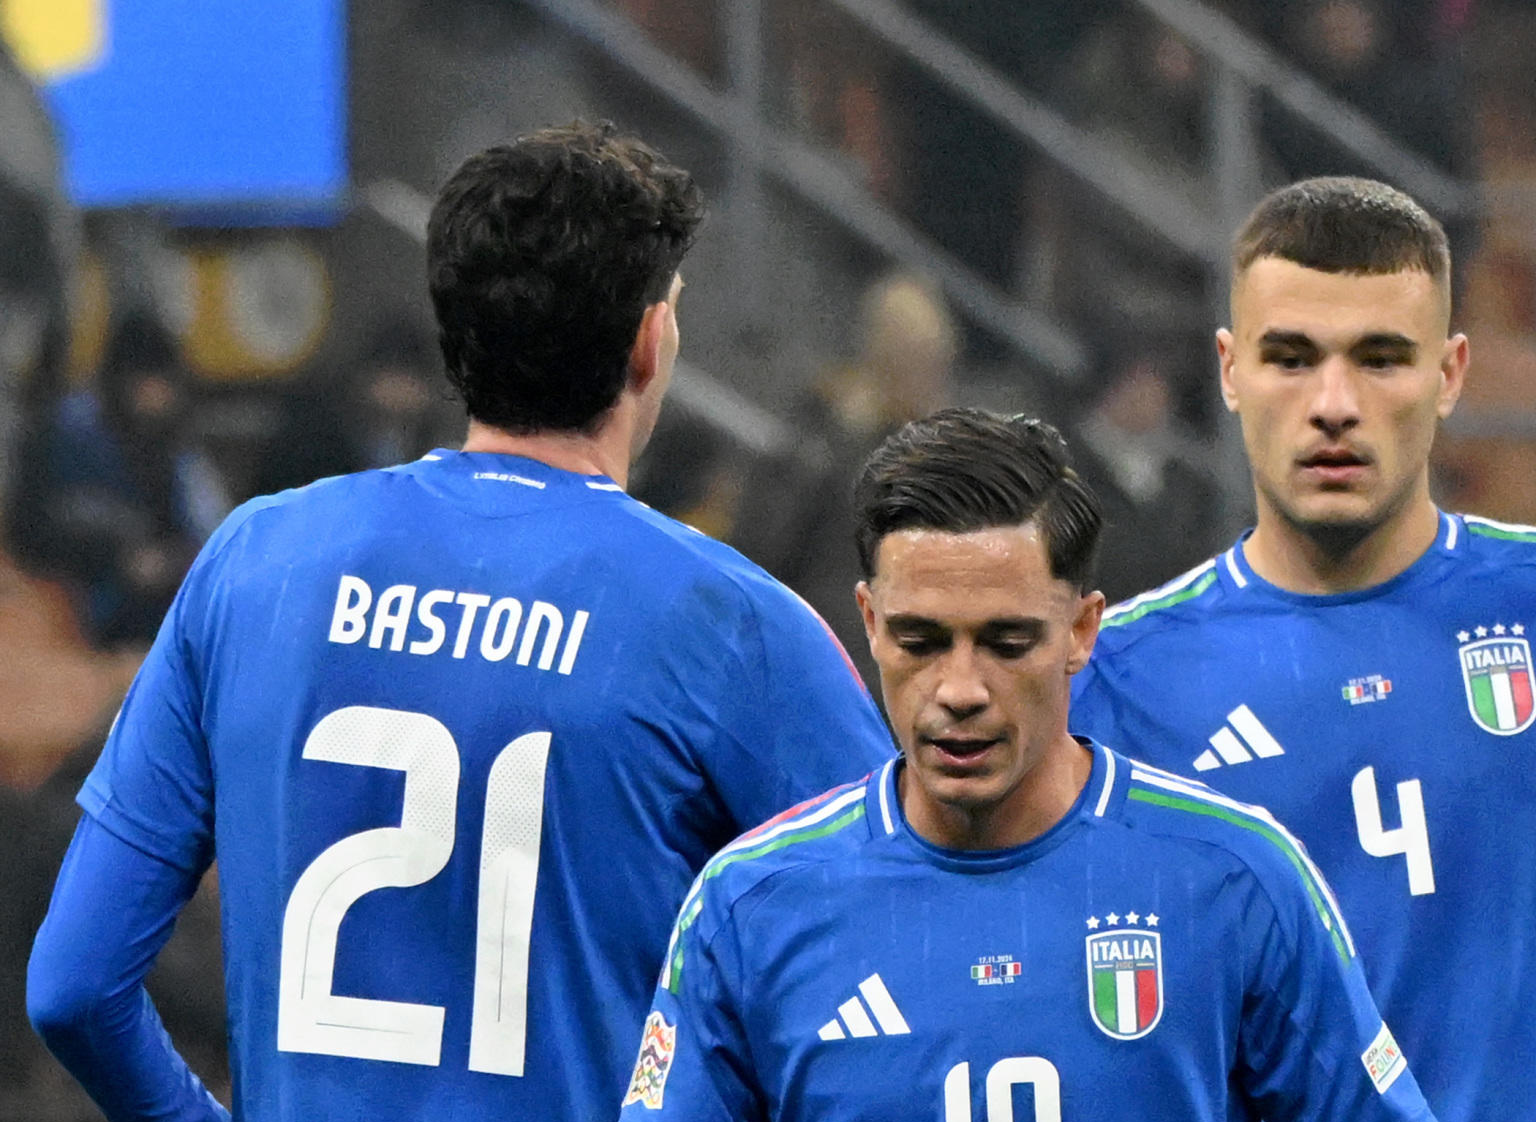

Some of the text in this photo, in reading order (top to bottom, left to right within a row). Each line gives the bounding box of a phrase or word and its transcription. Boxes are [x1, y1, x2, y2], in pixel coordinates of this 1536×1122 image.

[329, 576, 589, 676] BASTONI
[1465, 645, 1525, 670] ITALIA
[1352, 767, 1434, 895] 4
[278, 706, 551, 1076] 21
[1092, 939, 1155, 962] ITALIA
